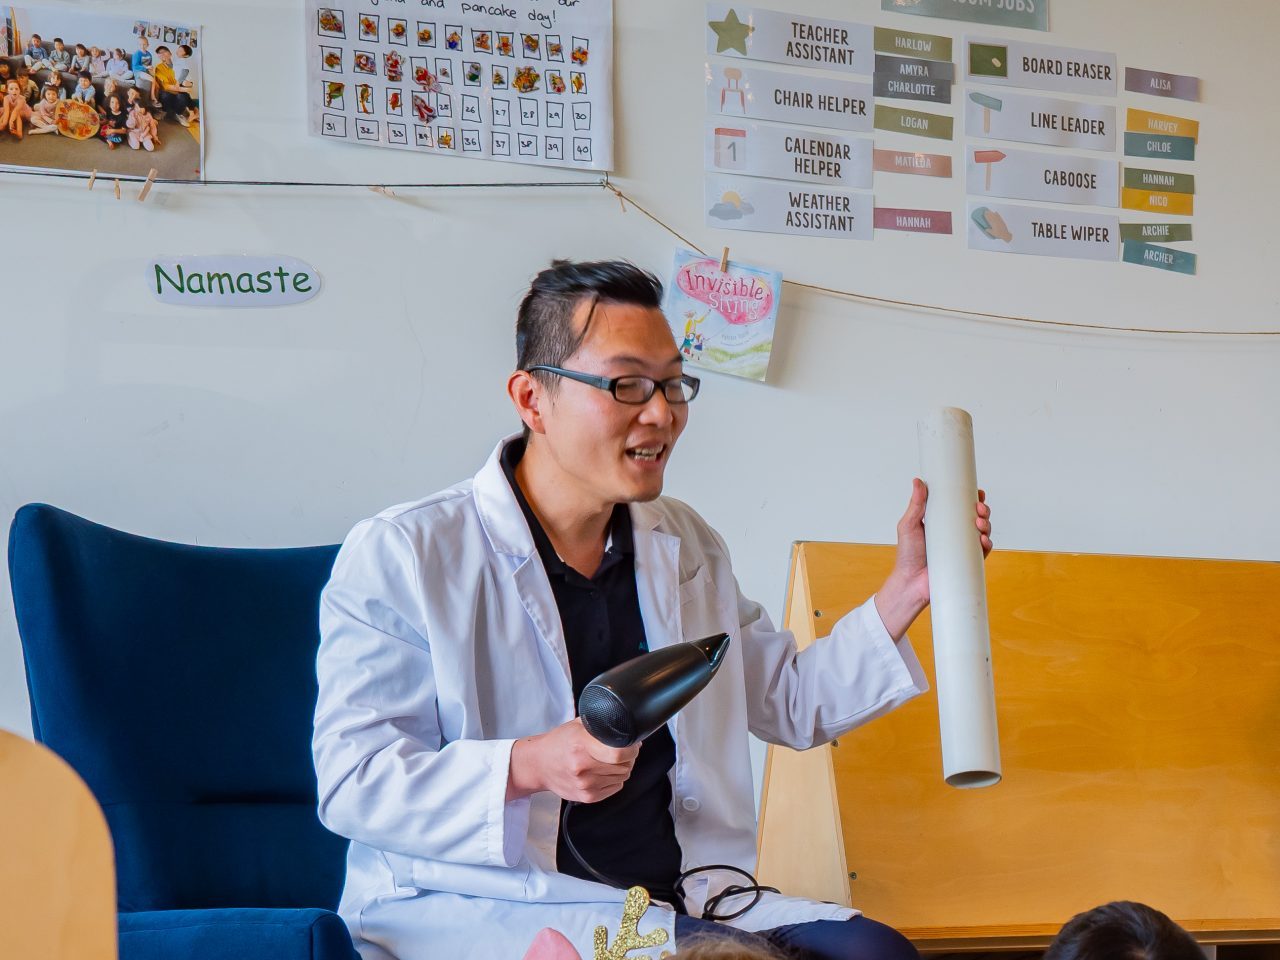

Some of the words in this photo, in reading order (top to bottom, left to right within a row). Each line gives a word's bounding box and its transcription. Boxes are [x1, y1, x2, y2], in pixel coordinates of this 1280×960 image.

[461, 3, 517, 19] pancake
[528, 10, 557, 29] day!
[791, 22, 849, 46] TEACHER
[895, 37, 932, 52] HARLOW
[786, 41, 855, 66] ASSISTANT
[899, 63, 929, 78] AMYRA
[1022, 56, 1063, 76] BOARD
[1066, 61, 1112, 81] ERASER
[888, 80, 936, 97] CHARLOTTE
[1150, 77, 1172, 92] ALISA
[774, 89, 814, 109] CHAIR
[818, 95, 867, 116] HELPER
[548, 112, 560, 120] 29
[575, 112, 587, 120] 30
[901, 115, 929, 130] LOGAN
[1031, 111, 1058, 130] LINE
[1061, 116, 1106, 136] LEADER
[1148, 118, 1178, 134] HARVEY
[325, 122, 336, 131] 31
[360, 126, 374, 134] 32
[392, 129, 404, 137] 33
[464, 137, 477, 146] 36
[495, 140, 506, 148] 37
[521, 140, 533, 148] 38
[547, 143, 559, 152] 39
[577, 146, 589, 155] 40
[784, 136, 852, 161] CALENDAR
[1146, 140, 1172, 153] CHLOE
[794, 158, 842, 179] HELPER
[1044, 169, 1097, 190] CABOOSE
[1142, 173, 1175, 187] HANNAH
[789, 191, 851, 213] WEATHER
[1149, 194, 1168, 207] NICO
[786, 211, 855, 232] ASSISTANT
[896, 216, 931, 229] HANNAH
[1142, 224, 1170, 236] ARCHIE
[1031, 222, 1068, 240] TABLE
[1071, 225, 1110, 243] WIPER
[1143, 249, 1174, 265] ARCHER
[154, 264, 312, 295] Namaste
[686, 270, 765, 300] Invisible
